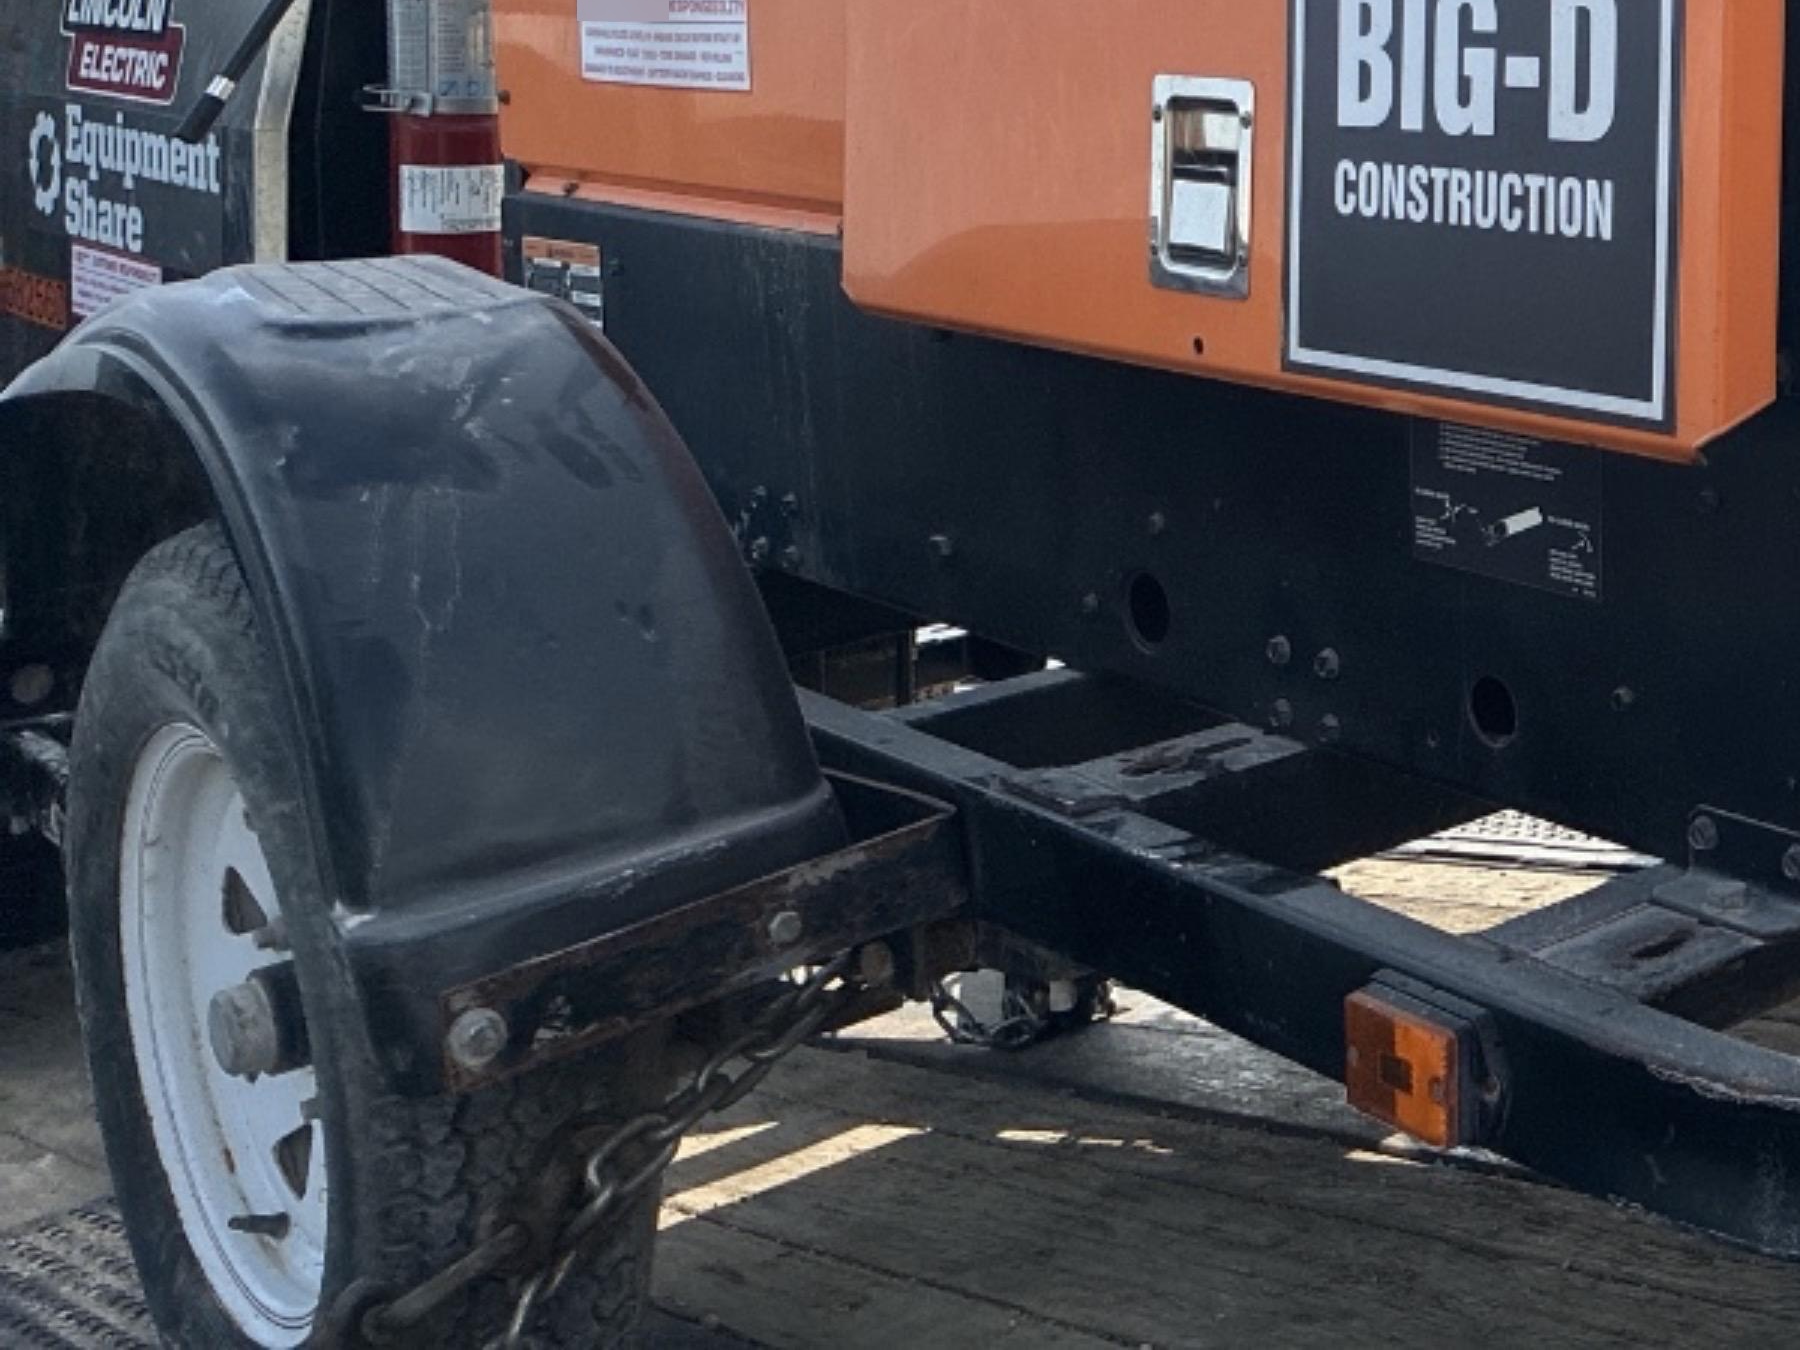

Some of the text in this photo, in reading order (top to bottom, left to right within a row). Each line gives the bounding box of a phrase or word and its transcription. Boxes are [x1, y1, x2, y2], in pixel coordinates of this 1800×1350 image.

[78, 42, 170, 92] ELECTRIC
[65, 103, 221, 194] Equipment
[64, 176, 144, 254] Share
[1334, 159, 1614, 242] CONSTRUCTION
